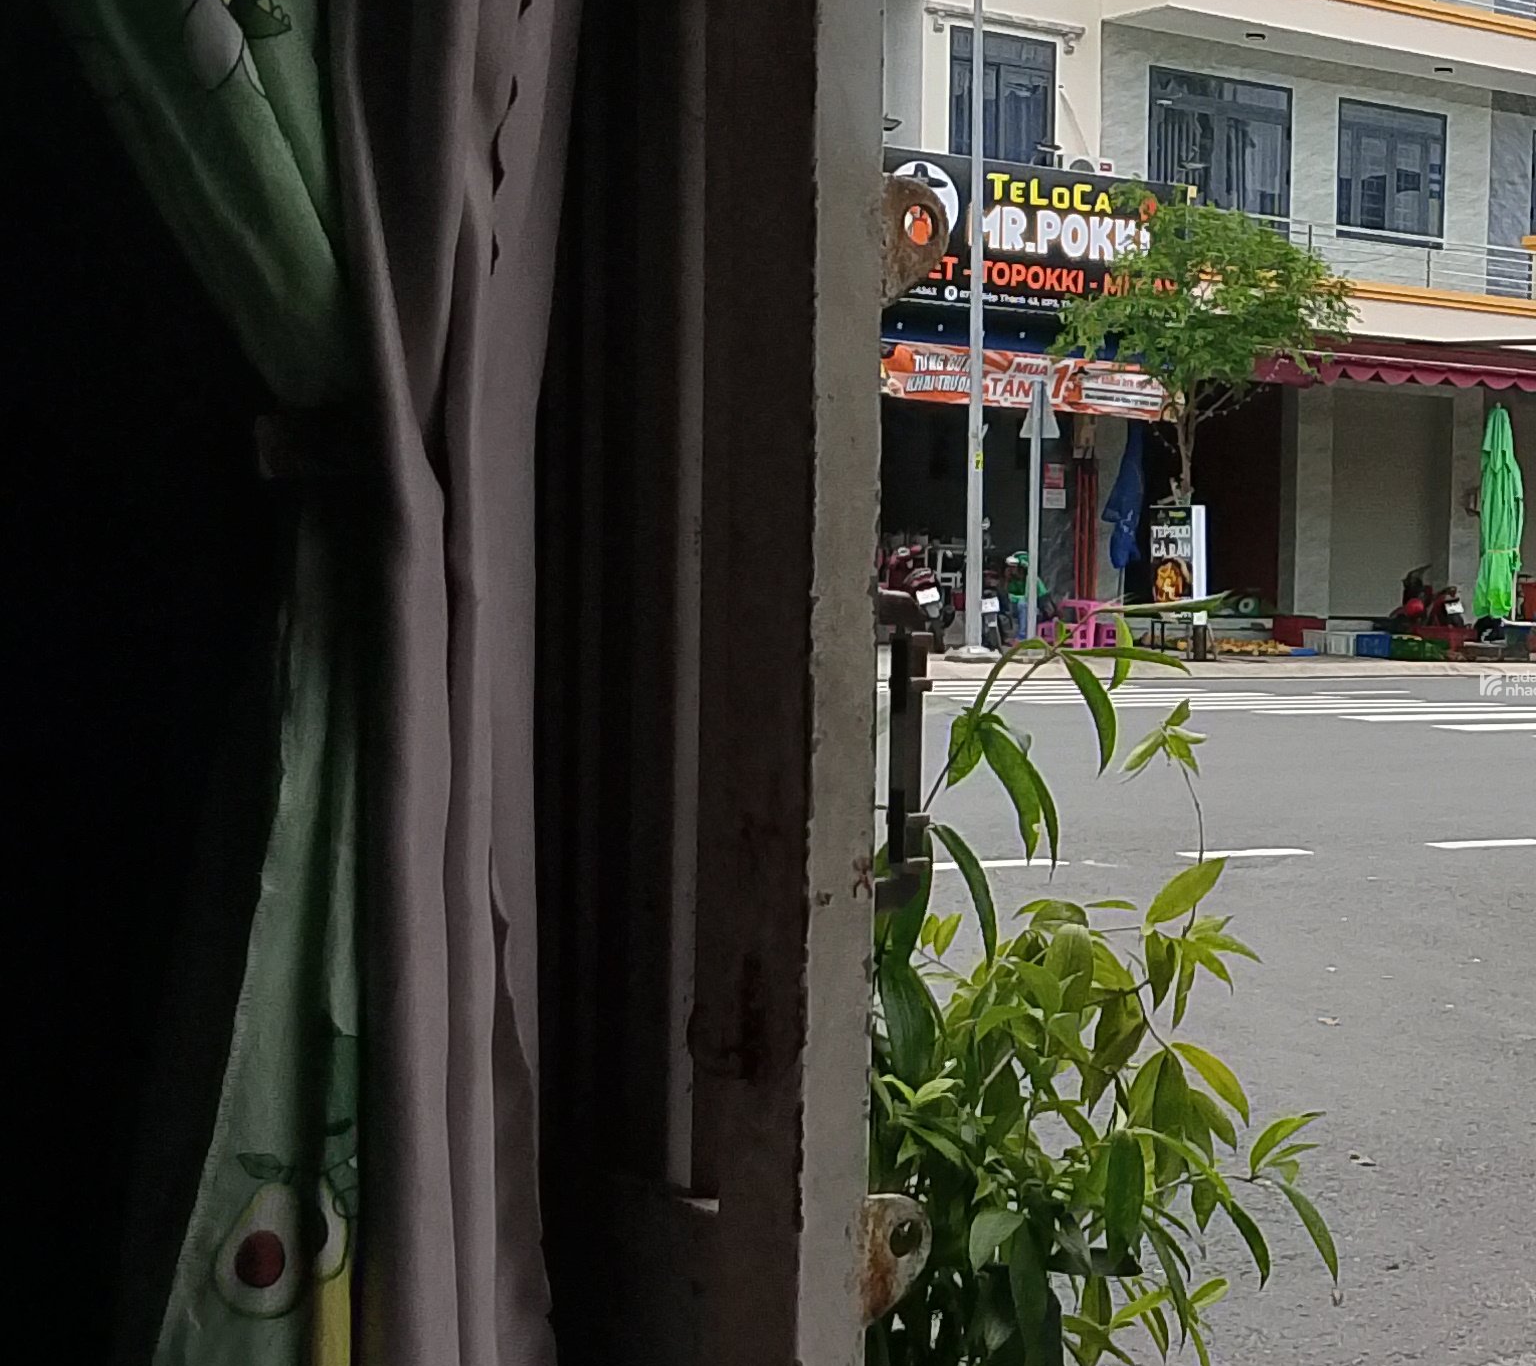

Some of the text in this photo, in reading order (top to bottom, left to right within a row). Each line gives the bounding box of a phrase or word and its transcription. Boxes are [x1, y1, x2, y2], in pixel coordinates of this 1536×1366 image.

[982, 260, 1085, 294] TOPOKKI
[1013, 362, 1048, 376] MUA
[1052, 364, 1070, 400] 1
[989, 373, 1034, 403] TẶN
